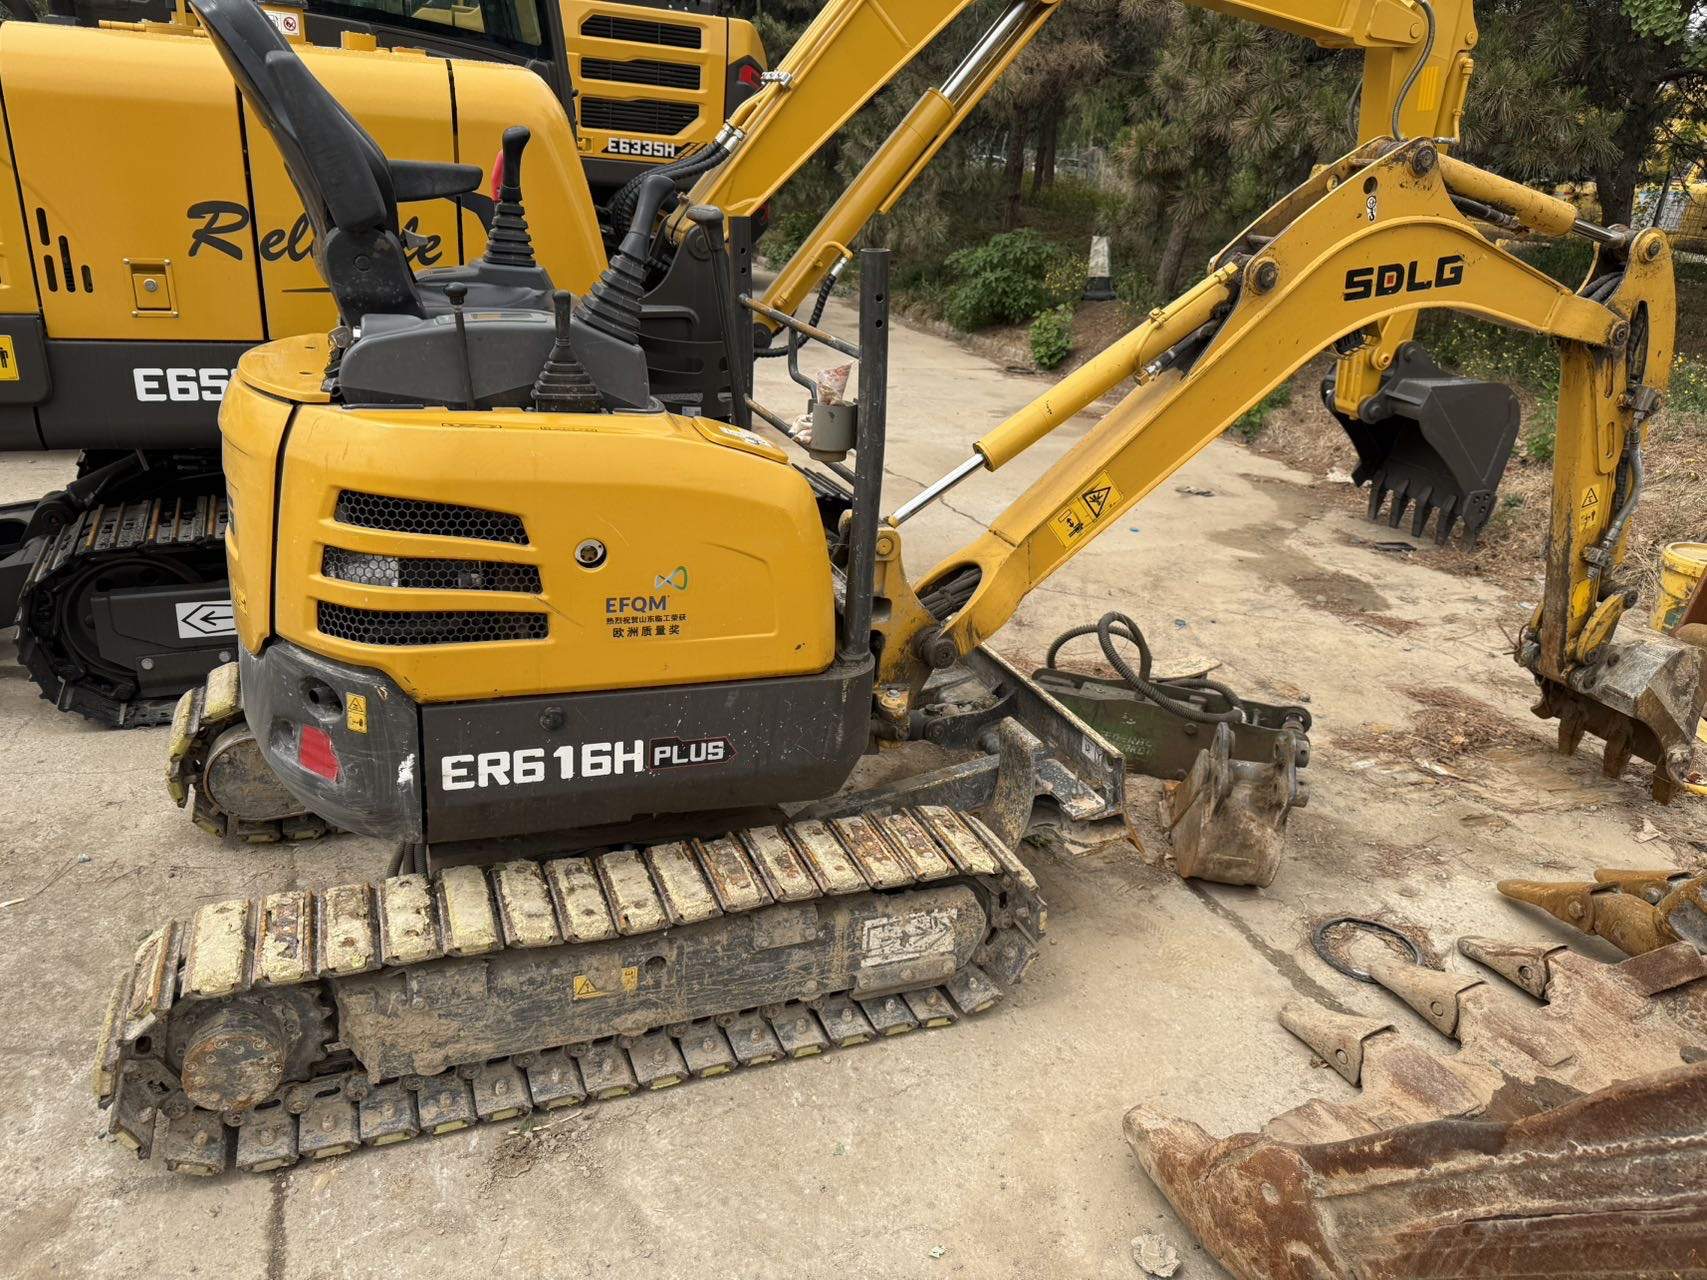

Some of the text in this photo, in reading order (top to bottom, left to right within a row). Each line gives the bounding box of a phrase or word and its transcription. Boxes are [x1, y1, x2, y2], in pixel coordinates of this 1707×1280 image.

[608, 137, 675, 157] E6335H
[1343, 254, 1464, 301] SDLG
[133, 367, 238, 402] E65
[606, 595, 667, 613] EFQM
[613, 624, 680, 637] 欧洲质量奖
[441, 739, 725, 791] ER616H PLUS
